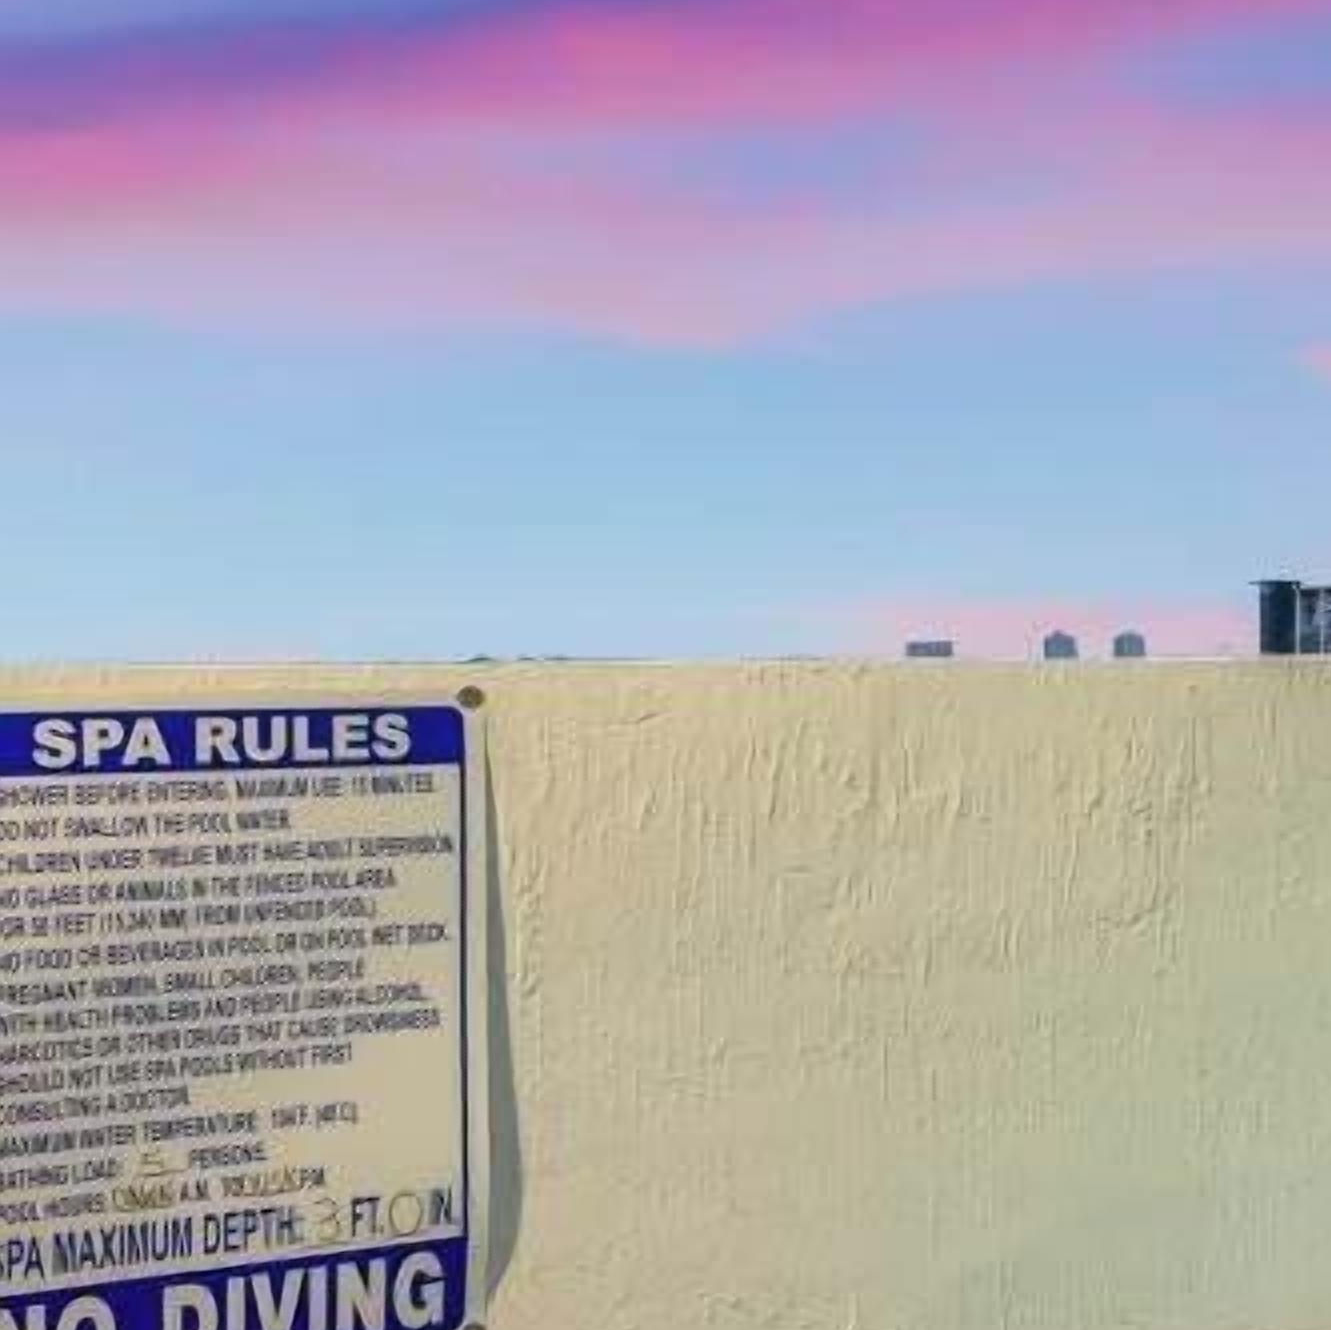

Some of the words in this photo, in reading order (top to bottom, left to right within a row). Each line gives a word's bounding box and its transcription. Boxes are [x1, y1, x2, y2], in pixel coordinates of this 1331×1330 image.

[32, 717, 172, 769] SPA
[195, 713, 411, 763] RULES
[75, 783, 139, 806] BEFORE
[236, 777, 308, 800] MAXIMUM
[25, 818, 58, 840] NOT
[64, 814, 147, 838] SWALLOW
[155, 812, 184, 835] THE
[189, 810, 231, 833] POOL
[86, 848, 141, 872] UNDER
[148, 844, 213, 868] TWELVE
[216, 842, 257, 864] MUST
[263, 840, 304, 862] HAVE
[307, 837, 352, 859] ADULT
[25, 883, 81, 908] GLASS
[88, 881, 111, 905] OR
[115, 878, 187, 903] ANIMALS
[193, 877, 206, 899] IN
[211, 875, 240, 898] THE
[246, 872, 306, 895] FENCED
[310, 870, 352, 892] POOL
[55, 911, 95, 936] FEET
[195, 904, 240, 927] FROM
[244, 899, 324, 924] UNFENCED
[25, 948, 72, 972] FOOD
[78, 946, 101, 969] OR
[107, 939, 204, 967] BEVERAGES
[209, 938, 224, 960] IN
[229, 935, 271, 959] POOL
[276, 933, 297, 956] OR
[301, 931, 324, 954] ON
[327, 928, 367, 952] POOL
[164, 971, 213, 992] SMALL
[306, 958, 364, 980] PEOPLE
[43, 1008, 107, 1031] HEALTH
[111, 1001, 200, 1026] PROBLEMS
[204, 998, 236, 1020] AND
[239, 993, 300, 1016] PEOPLE
[304, 989, 351, 1011] USING
[97, 1035, 121, 1055] OR
[127, 1031, 181, 1053] OTHER
[186, 1026, 240, 1048] DRUGS
[245, 1023, 281, 1043] THAT
[287, 1018, 337, 1039] CAUSE
[68, 1066, 102, 1087] NOT
[108, 1063, 140, 1083] USE
[145, 1060, 176, 1080] SPA
[179, 1055, 233, 1077] POOLS
[236, 1047, 308, 1072] WITHOUT
[311, 1043, 352, 1065] FIRST
[107, 1094, 119, 1112] A
[80, 1124, 136, 1148] WATER
[53, 1215, 194, 1276] MAXIMUM
[315, 1197, 341, 1243] 3
[351, 1196, 385, 1238] FT.
